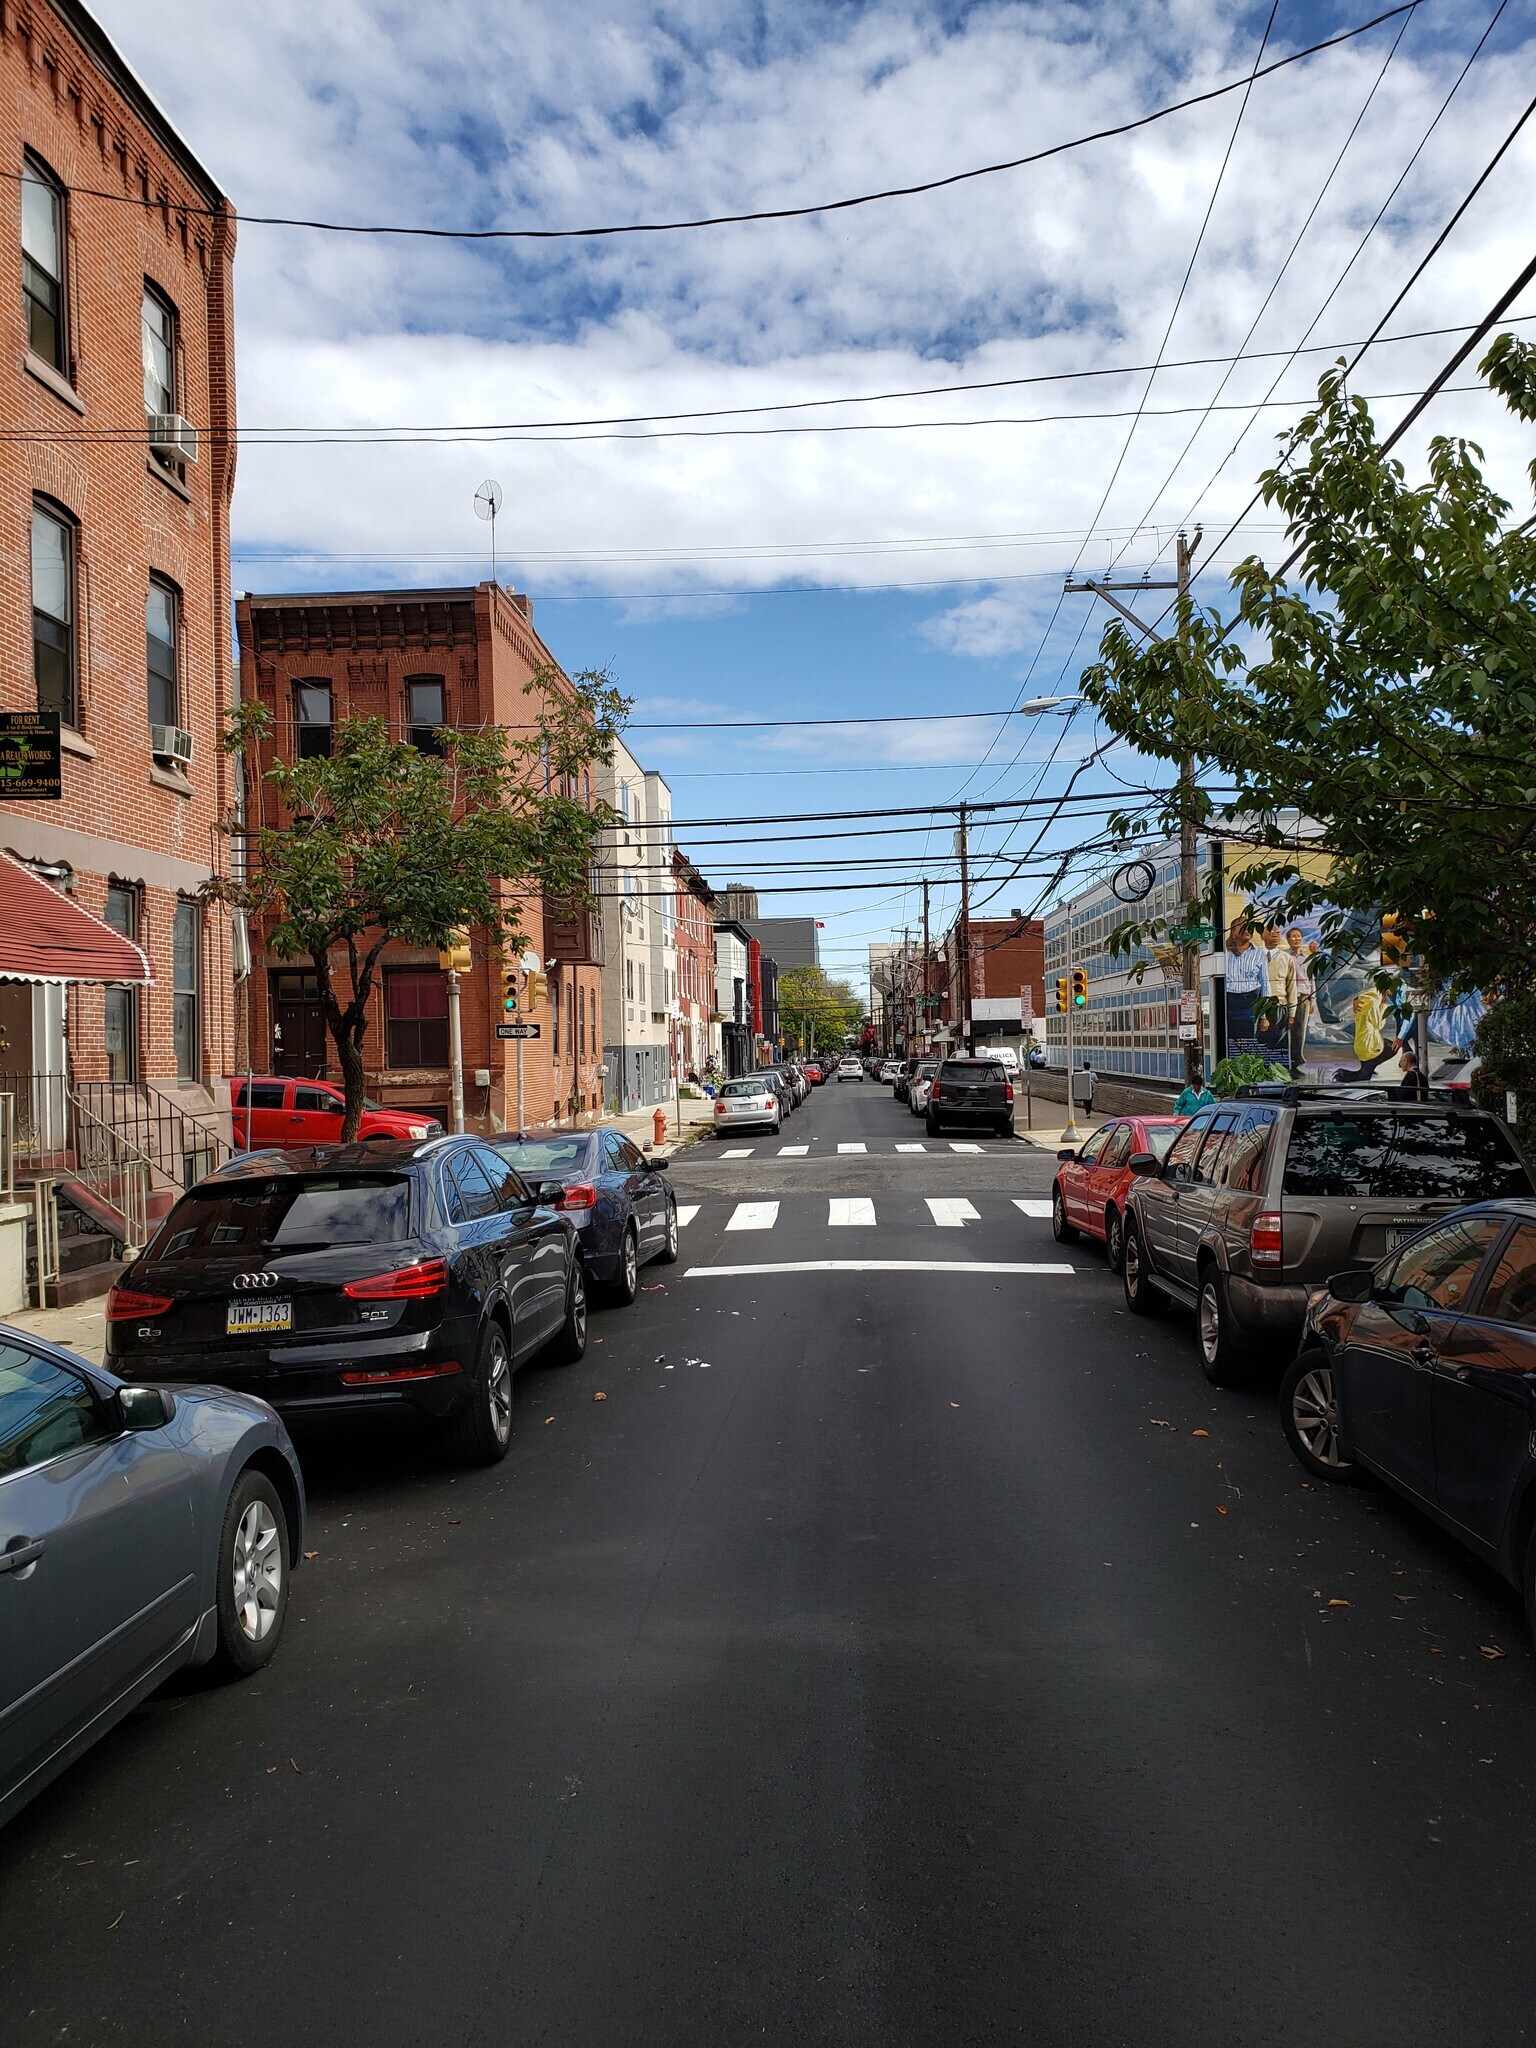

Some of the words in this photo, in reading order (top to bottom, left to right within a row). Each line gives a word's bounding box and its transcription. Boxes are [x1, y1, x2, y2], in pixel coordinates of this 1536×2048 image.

[10, 715, 23, 725] FOR
[24, 715, 40, 725] RENT
[1, 779, 60, 787] 15-669-9400
[138, 1328, 161, 1337] Q3
